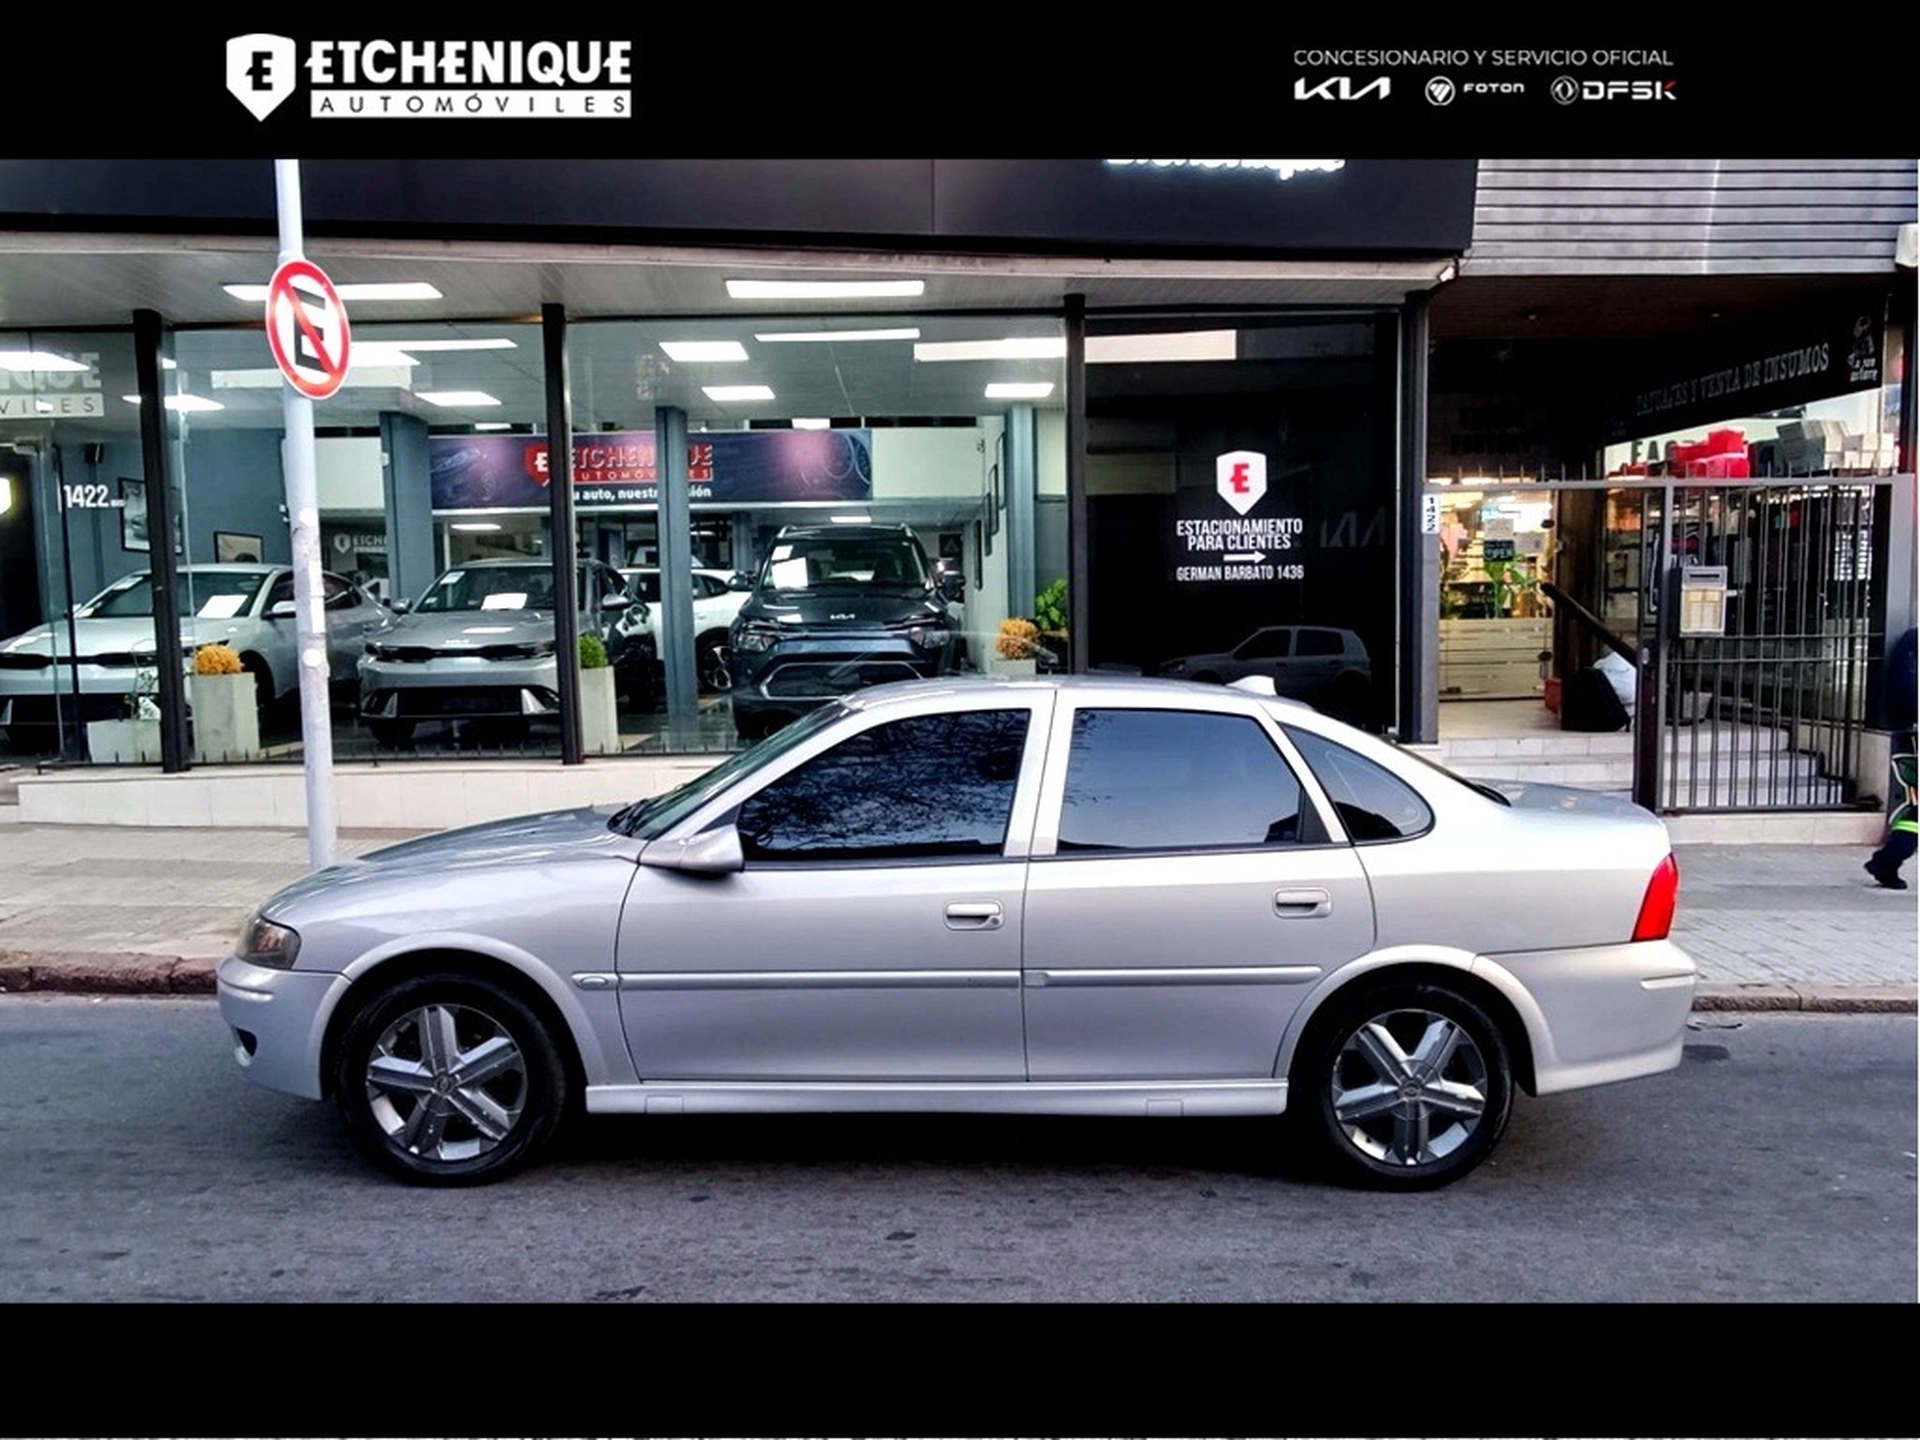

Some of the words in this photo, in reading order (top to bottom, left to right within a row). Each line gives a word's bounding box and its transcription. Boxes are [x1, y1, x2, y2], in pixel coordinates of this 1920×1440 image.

[1743, 360, 1762, 389] DE
[1763, 342, 1830, 384] INSUMOS
[63, 484, 110, 508] 1422
[582, 489, 615, 502] auto,
[617, 487, 658, 499] nuestr
[1176, 517, 1303, 536] ESTACIONAMIENTO
[1188, 534, 1224, 551] PARA
[1227, 532, 1292, 550] CLIENTES
[1176, 566, 1222, 581] GERMAN
[1224, 565, 1274, 580] BARBATO
